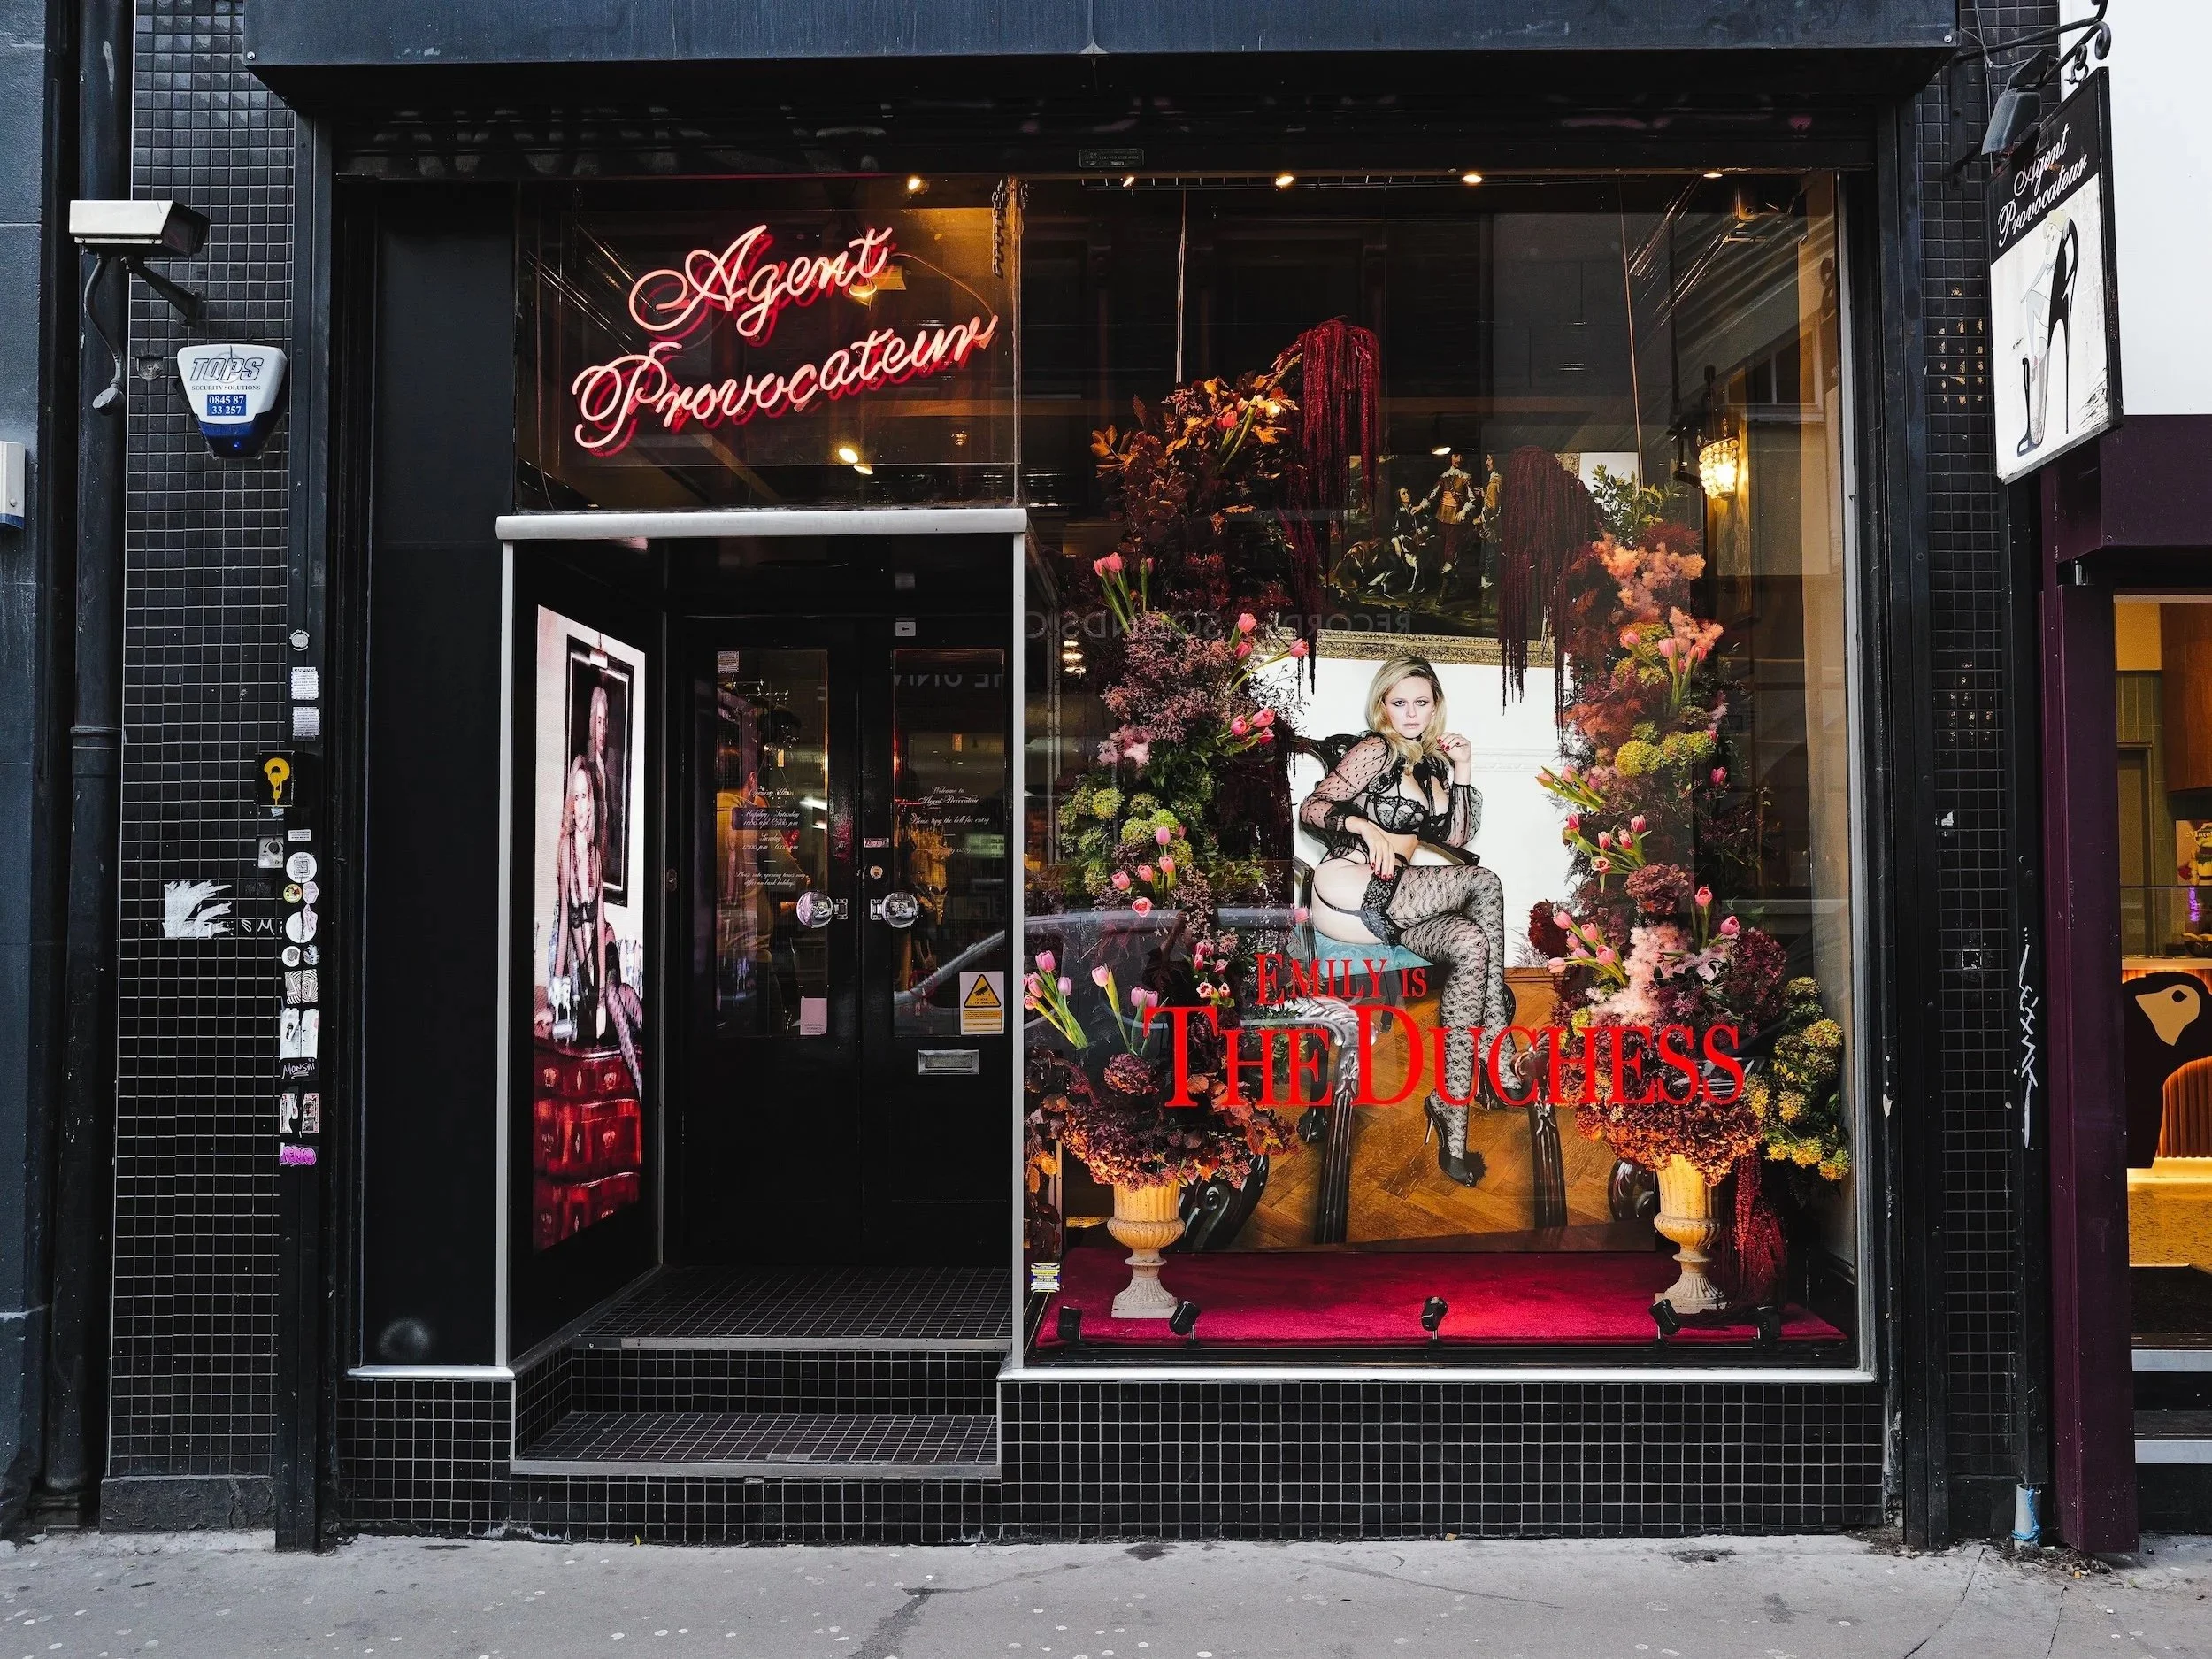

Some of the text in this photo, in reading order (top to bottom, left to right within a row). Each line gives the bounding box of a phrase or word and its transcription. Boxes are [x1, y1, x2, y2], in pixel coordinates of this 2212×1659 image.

[1997, 153, 2088, 248] Provocateur
[2013, 122, 2071, 196] Agent
[628, 224, 894, 338] Agent
[189, 357, 265, 381] TOPS
[209, 396, 244, 404] 0845 87
[572, 313, 999, 449] Provocateur
[1253, 953, 1427, 1006] EMILY IS
[1142, 1004, 1746, 1108] THE DUCHESS
